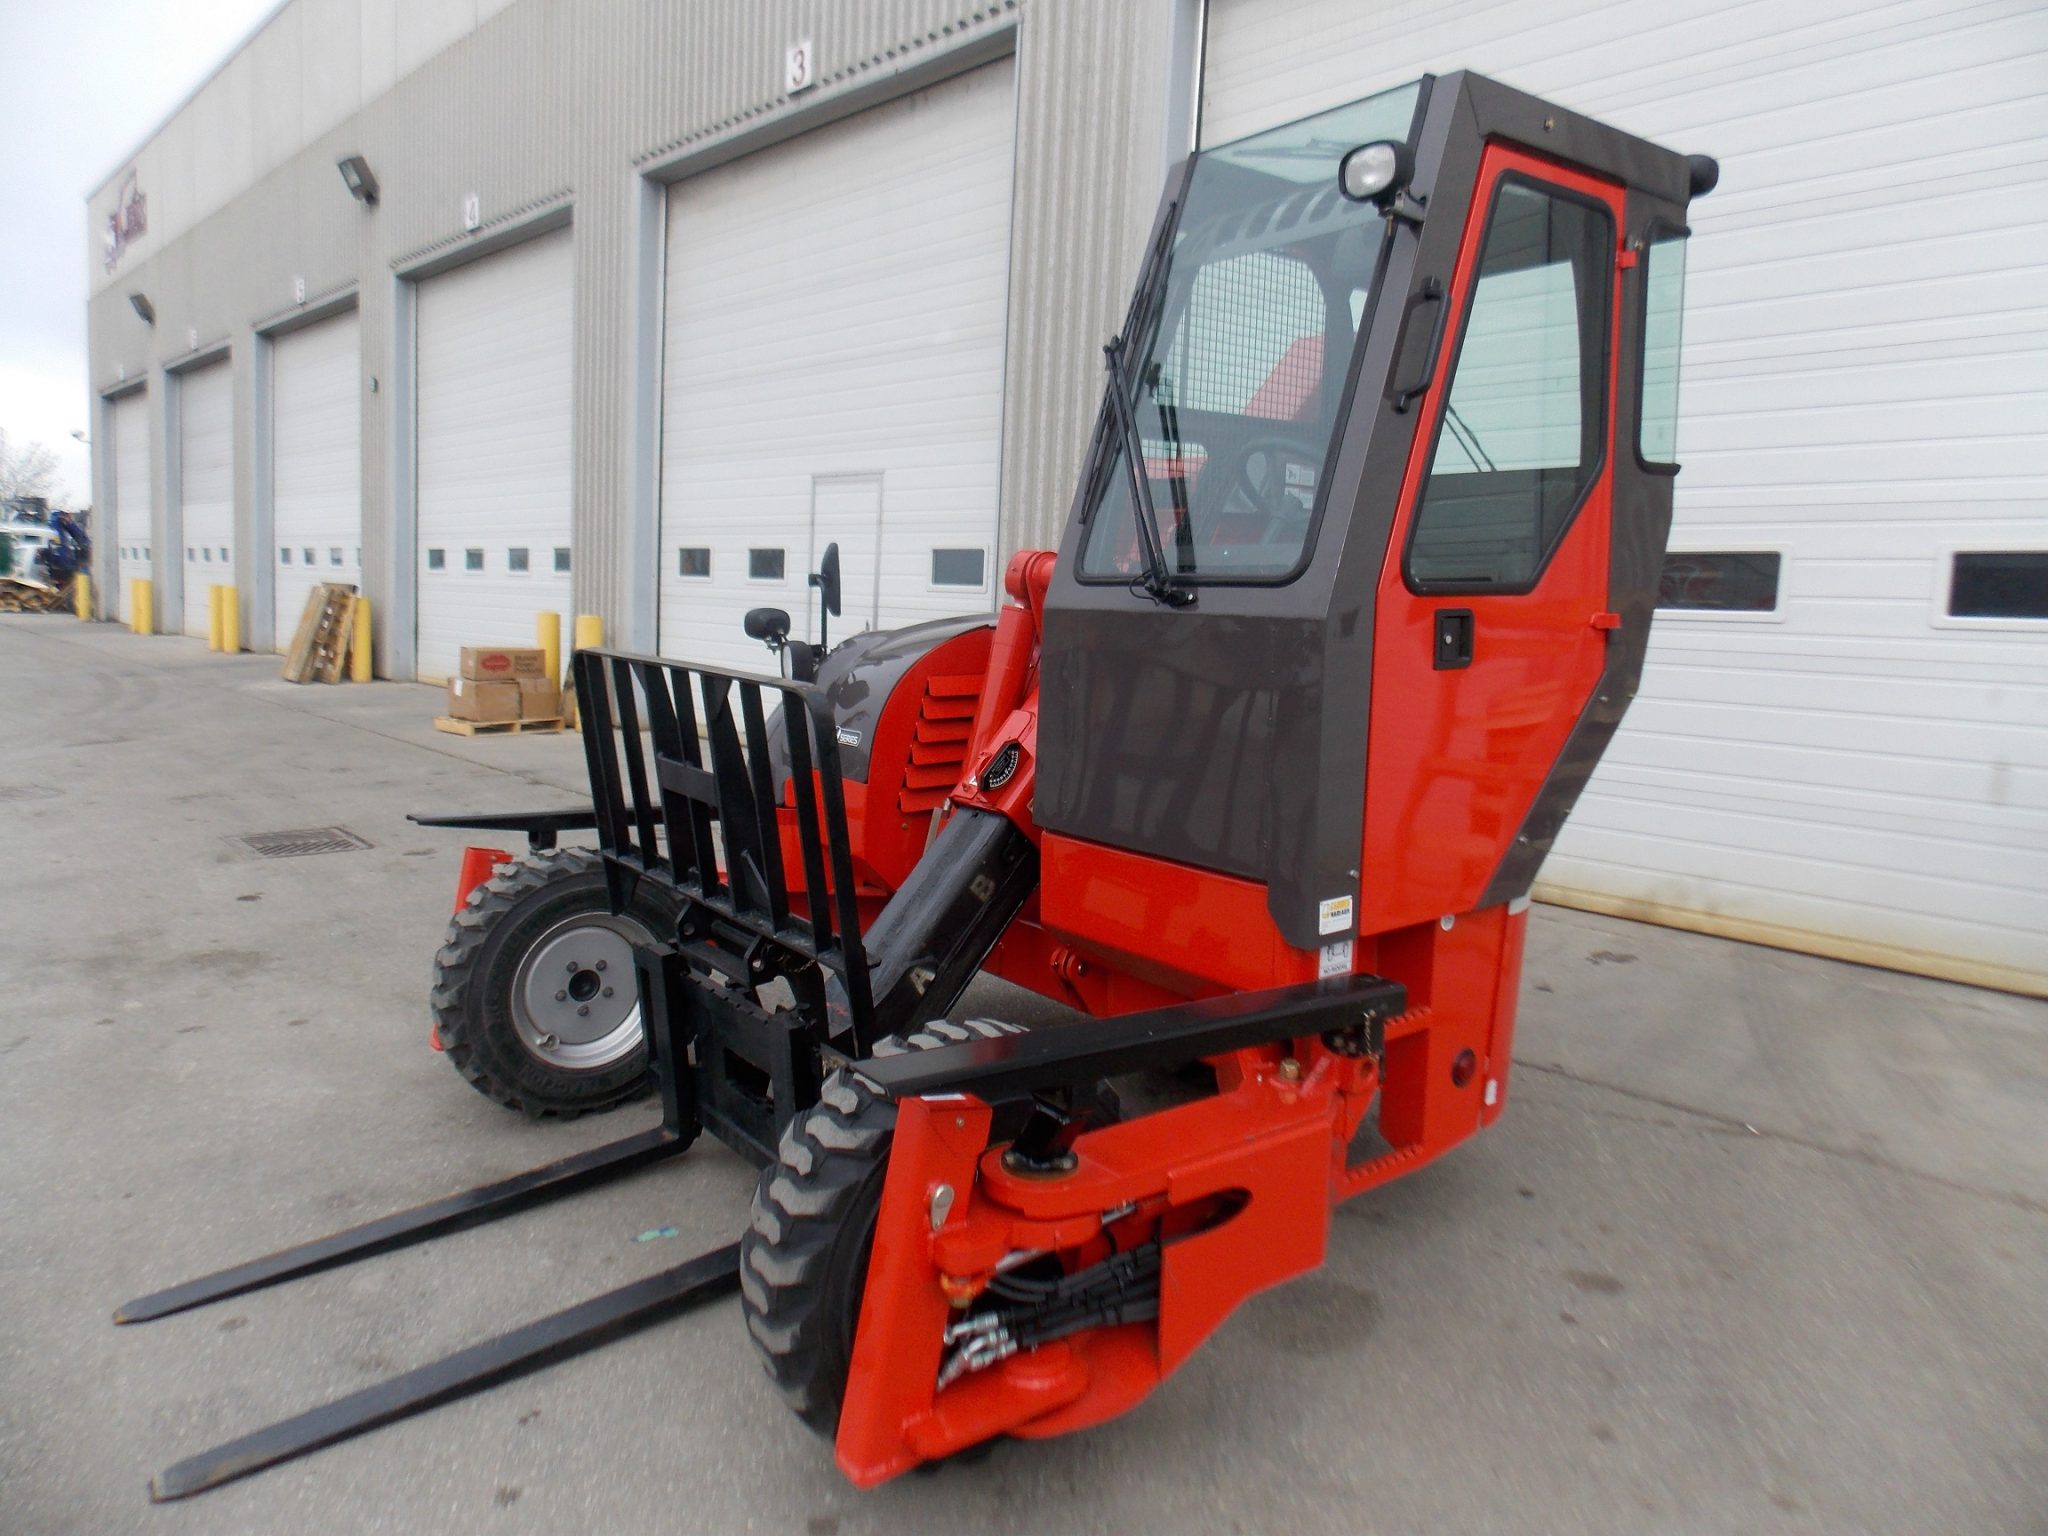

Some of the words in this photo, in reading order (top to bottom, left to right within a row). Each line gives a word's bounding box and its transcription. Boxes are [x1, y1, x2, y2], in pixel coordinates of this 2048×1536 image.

[792, 49, 806, 88] 3
[468, 200, 477, 225] 4
[969, 874, 996, 903] B
[909, 966, 936, 996] A
